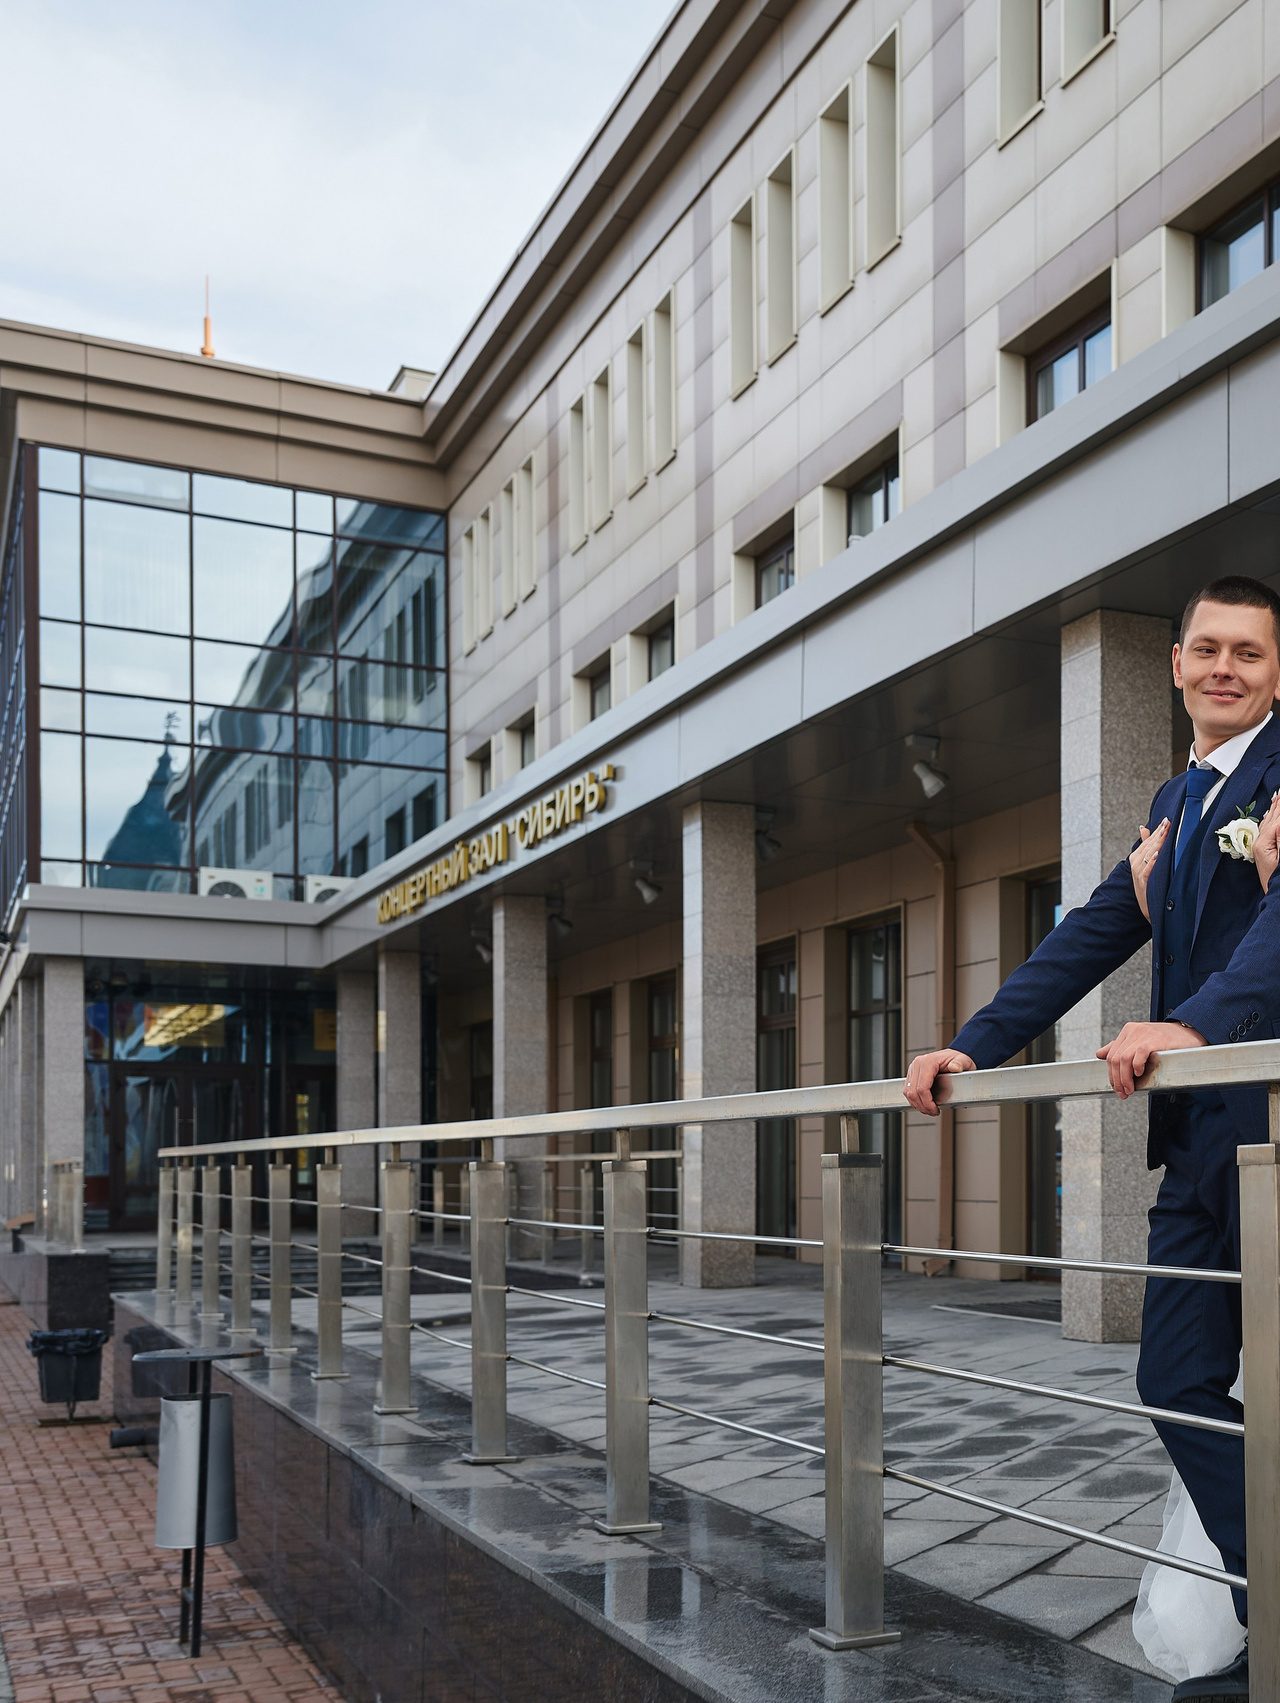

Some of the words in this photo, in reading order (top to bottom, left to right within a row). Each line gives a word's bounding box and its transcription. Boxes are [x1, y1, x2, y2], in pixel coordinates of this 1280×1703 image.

[377, 840, 469, 924] КОНЦЕРТНЫЙ
[468, 822, 508, 875] ЗАЛ
[508, 764, 616, 849] "СИБИРЬ"
